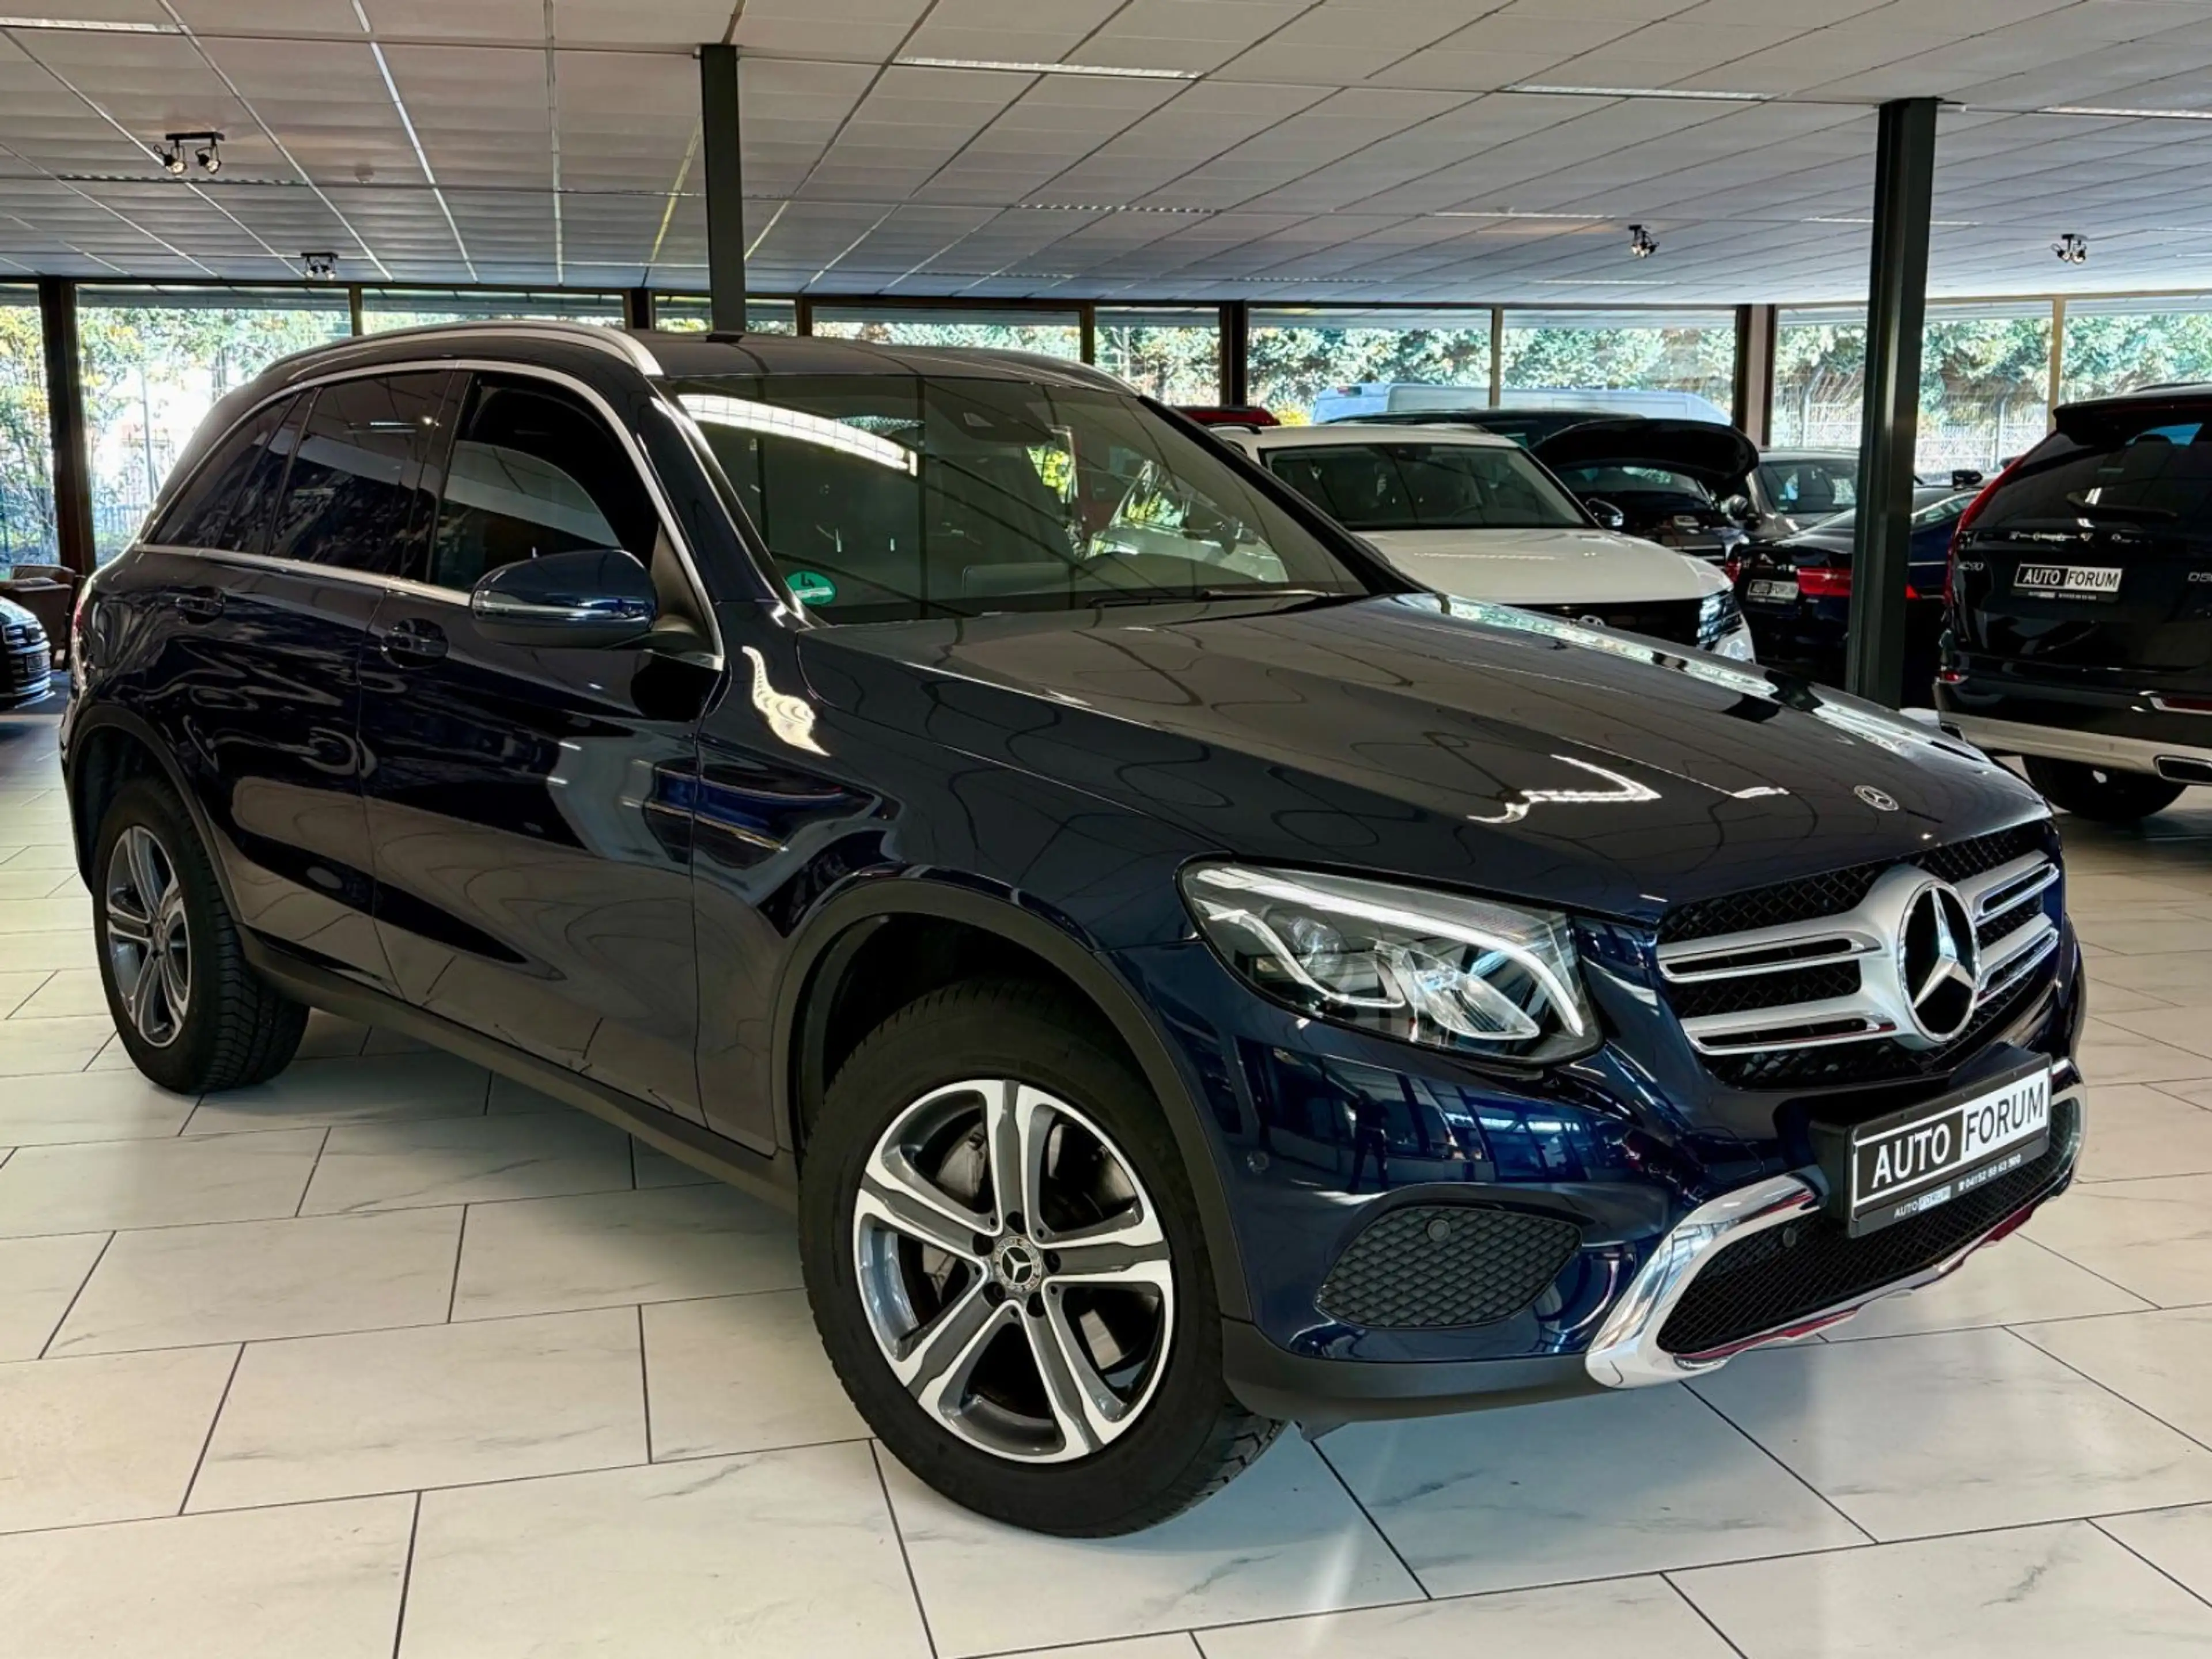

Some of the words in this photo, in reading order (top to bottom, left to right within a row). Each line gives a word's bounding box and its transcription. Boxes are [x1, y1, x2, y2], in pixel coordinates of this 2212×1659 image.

[2022, 568, 2061, 585] AUTO
[2066, 570, 2119, 588] FORUM
[1871, 1123, 1951, 1189] AUTO
[1964, 1081, 2044, 1152] FORUM
